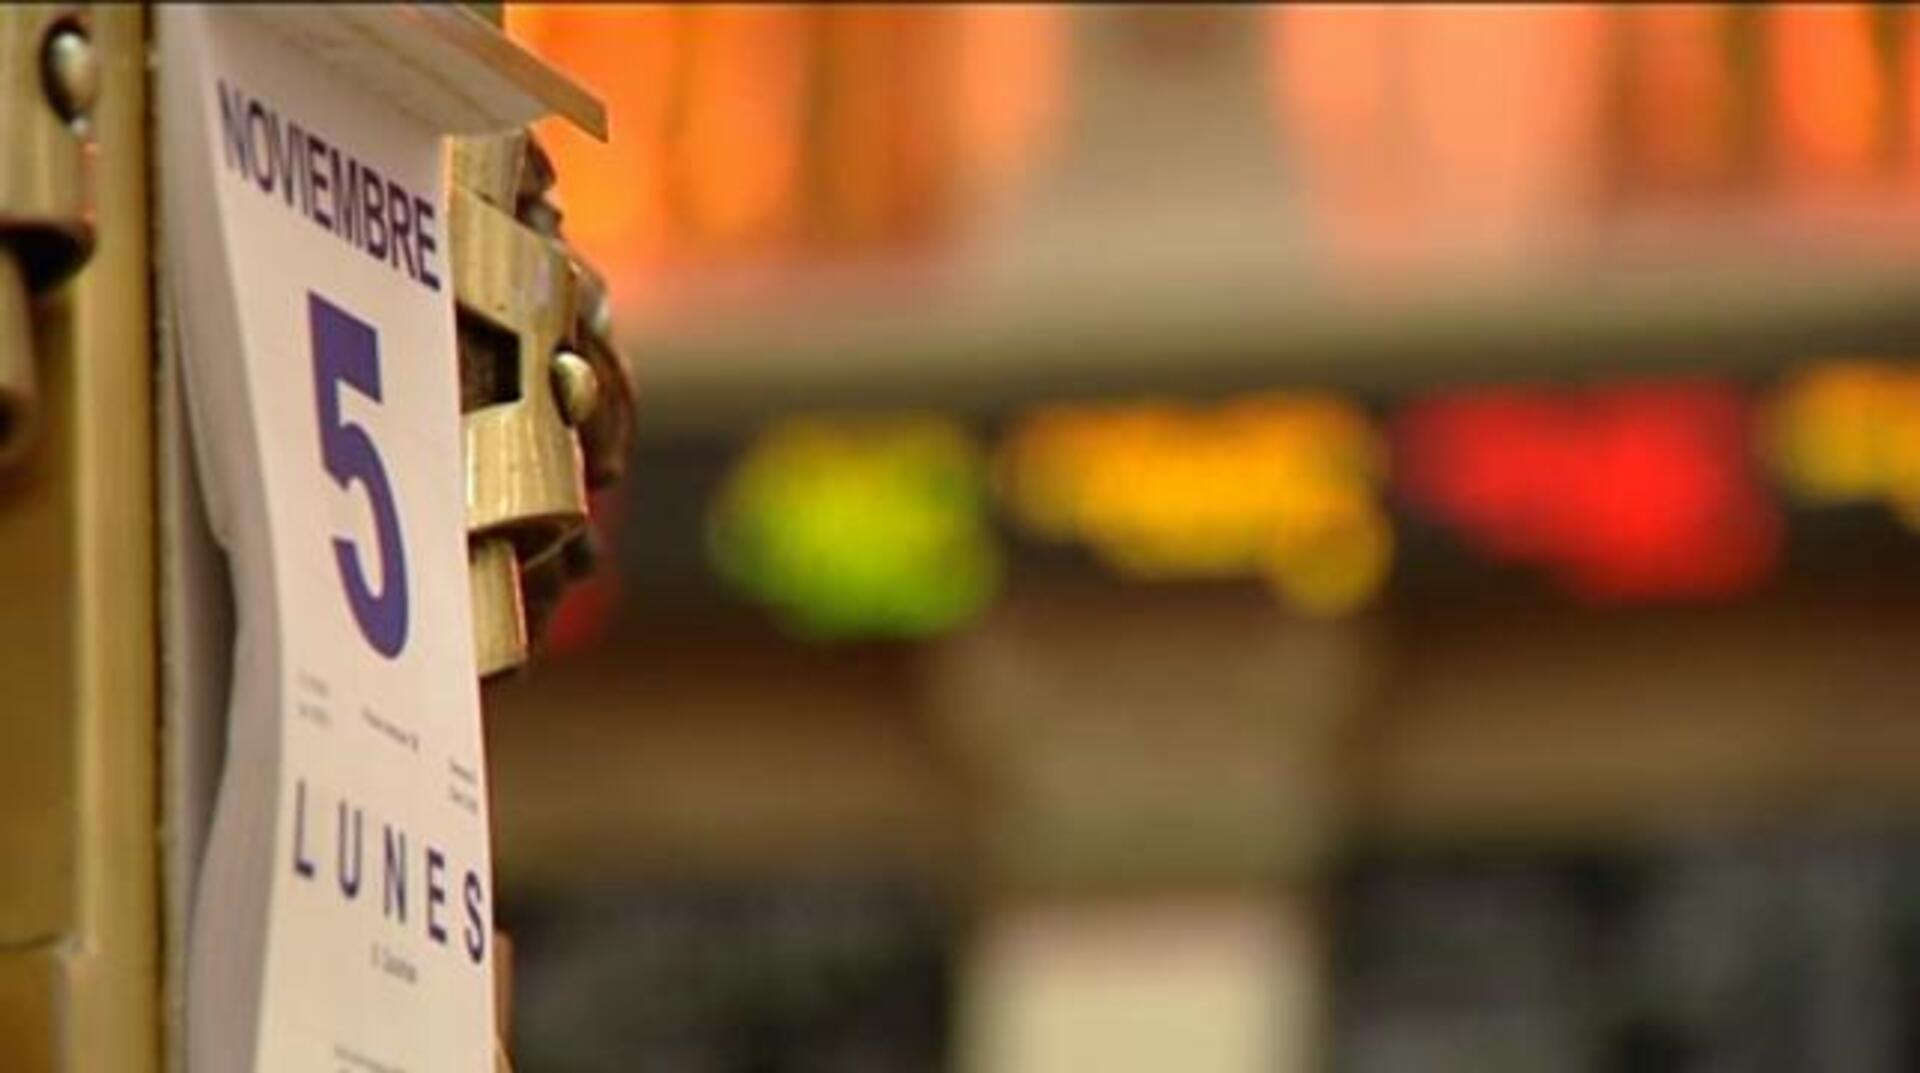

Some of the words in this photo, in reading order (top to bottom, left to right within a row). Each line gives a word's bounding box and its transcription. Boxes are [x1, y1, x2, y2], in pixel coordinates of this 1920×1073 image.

[217, 80, 441, 290] NOVIEMBRE
[307, 290, 409, 659] 5
[294, 779, 486, 964] LUNES
